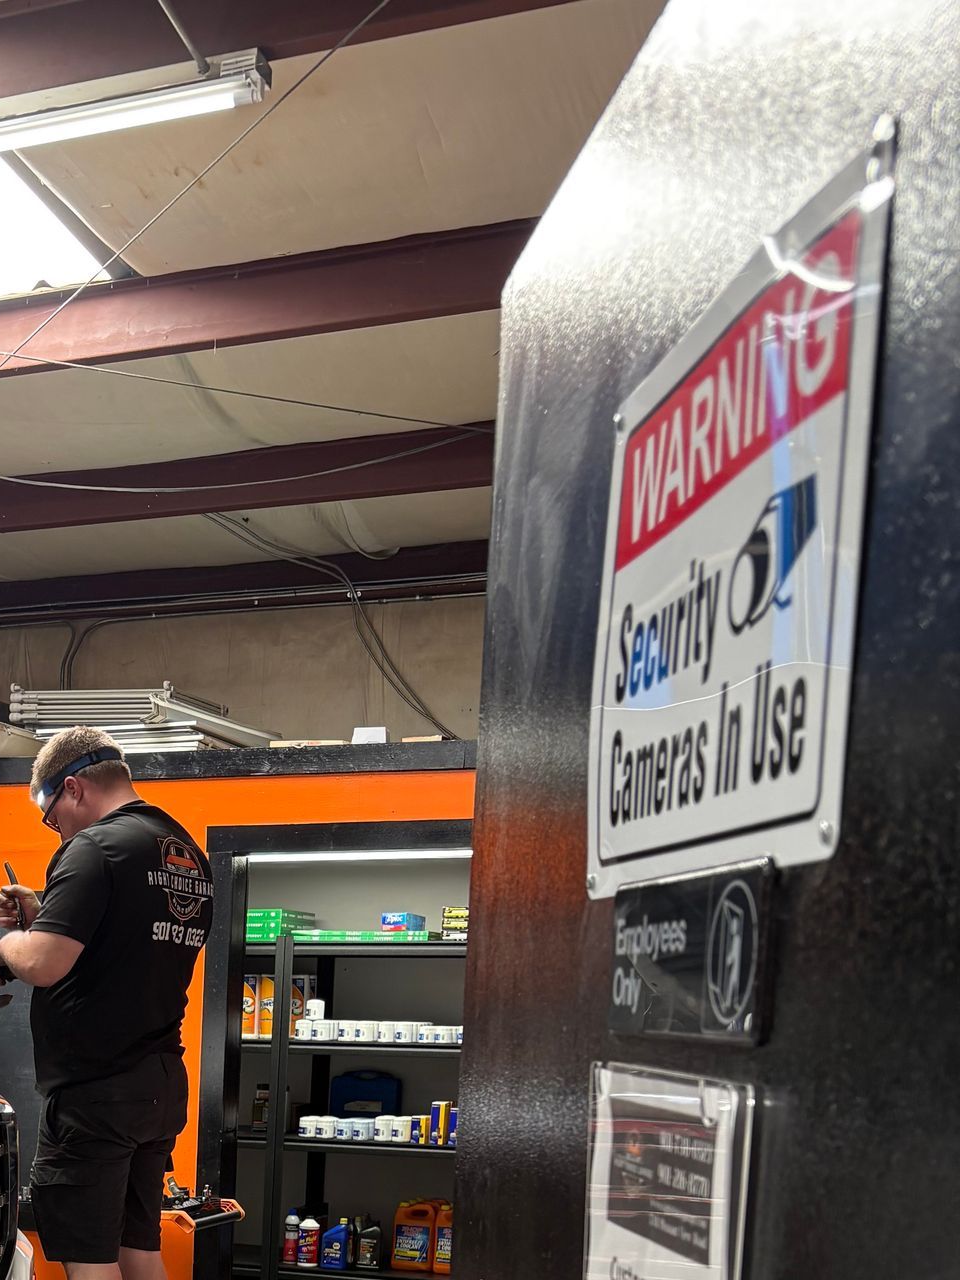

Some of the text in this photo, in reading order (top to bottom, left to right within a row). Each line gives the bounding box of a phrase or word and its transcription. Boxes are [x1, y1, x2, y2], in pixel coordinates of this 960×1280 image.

[631, 248, 843, 542] WARNING
[616, 560, 722, 704] Security
[609, 658, 807, 828] Cameras In Use
[147, 871, 170, 887] RIGHT
[170, 875, 193, 893] CHOICE
[152, 921, 171, 941] 901
[615, 915, 688, 962] Employees
[612, 967, 642, 1014] Only
